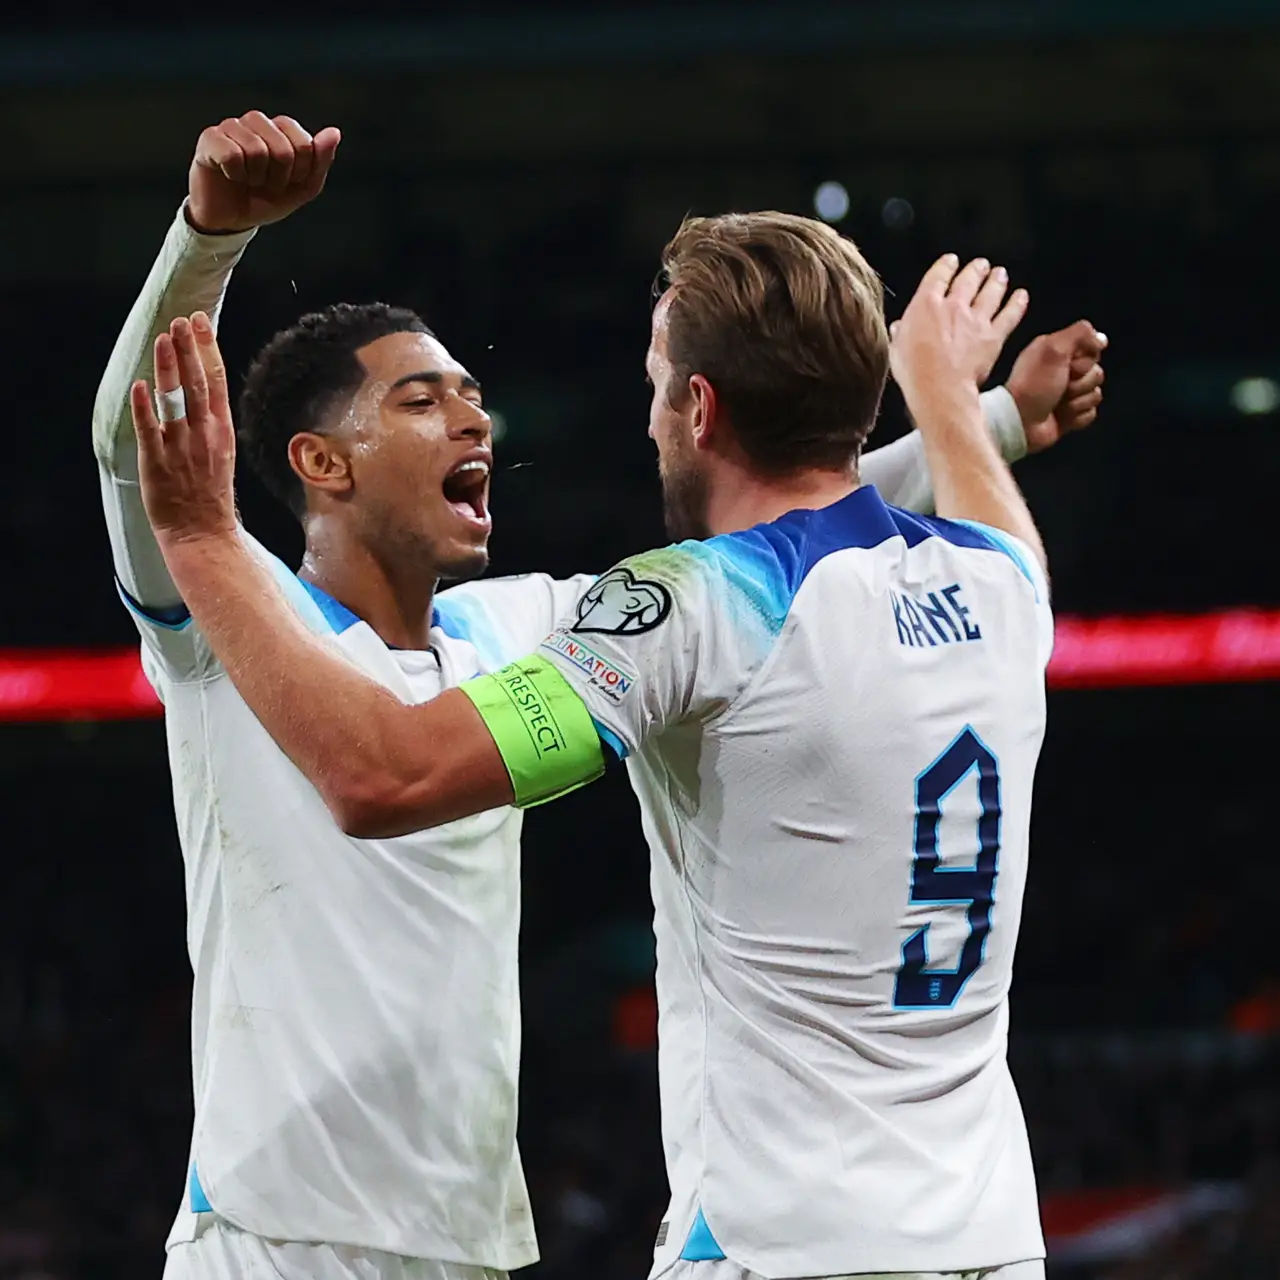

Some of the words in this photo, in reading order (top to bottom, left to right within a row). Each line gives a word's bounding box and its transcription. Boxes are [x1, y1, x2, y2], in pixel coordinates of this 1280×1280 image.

[888, 583, 982, 647] KANE
[506, 675, 560, 752] RESPECT
[892, 723, 1002, 1011] 9
